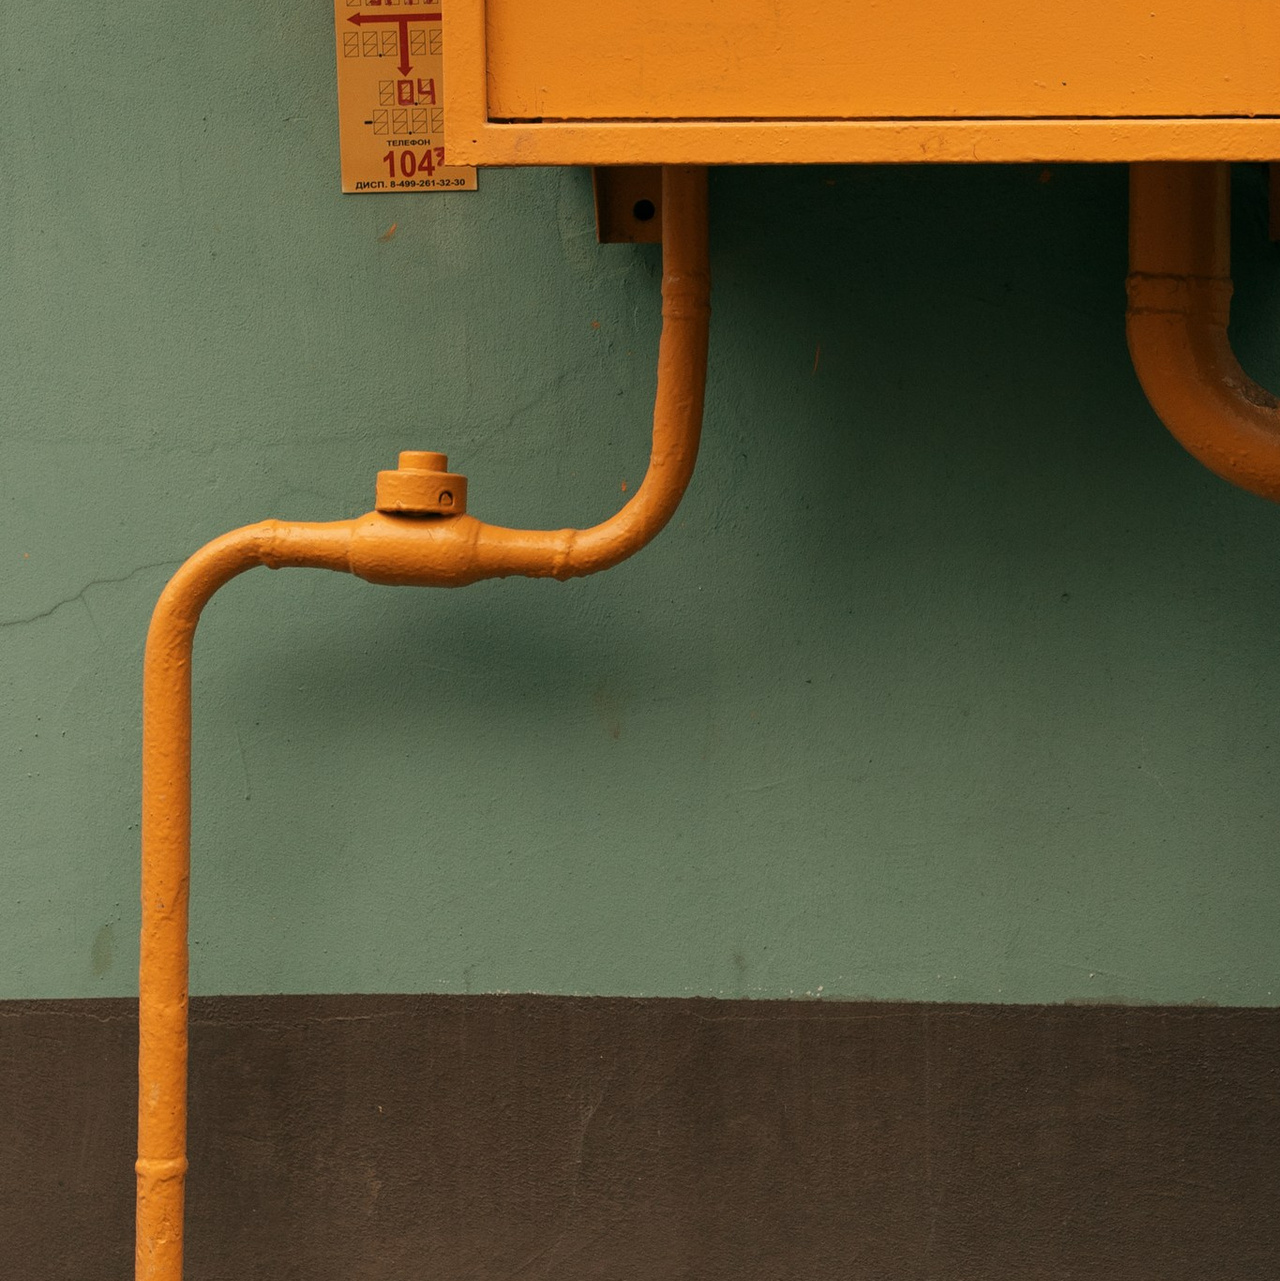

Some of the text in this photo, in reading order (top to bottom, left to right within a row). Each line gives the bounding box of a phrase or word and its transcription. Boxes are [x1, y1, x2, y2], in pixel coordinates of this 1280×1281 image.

[386, 139, 430, 147] ТЕЛЕФОН
[355, 178, 466, 190] ДИСП. 8-499-261-32-30
